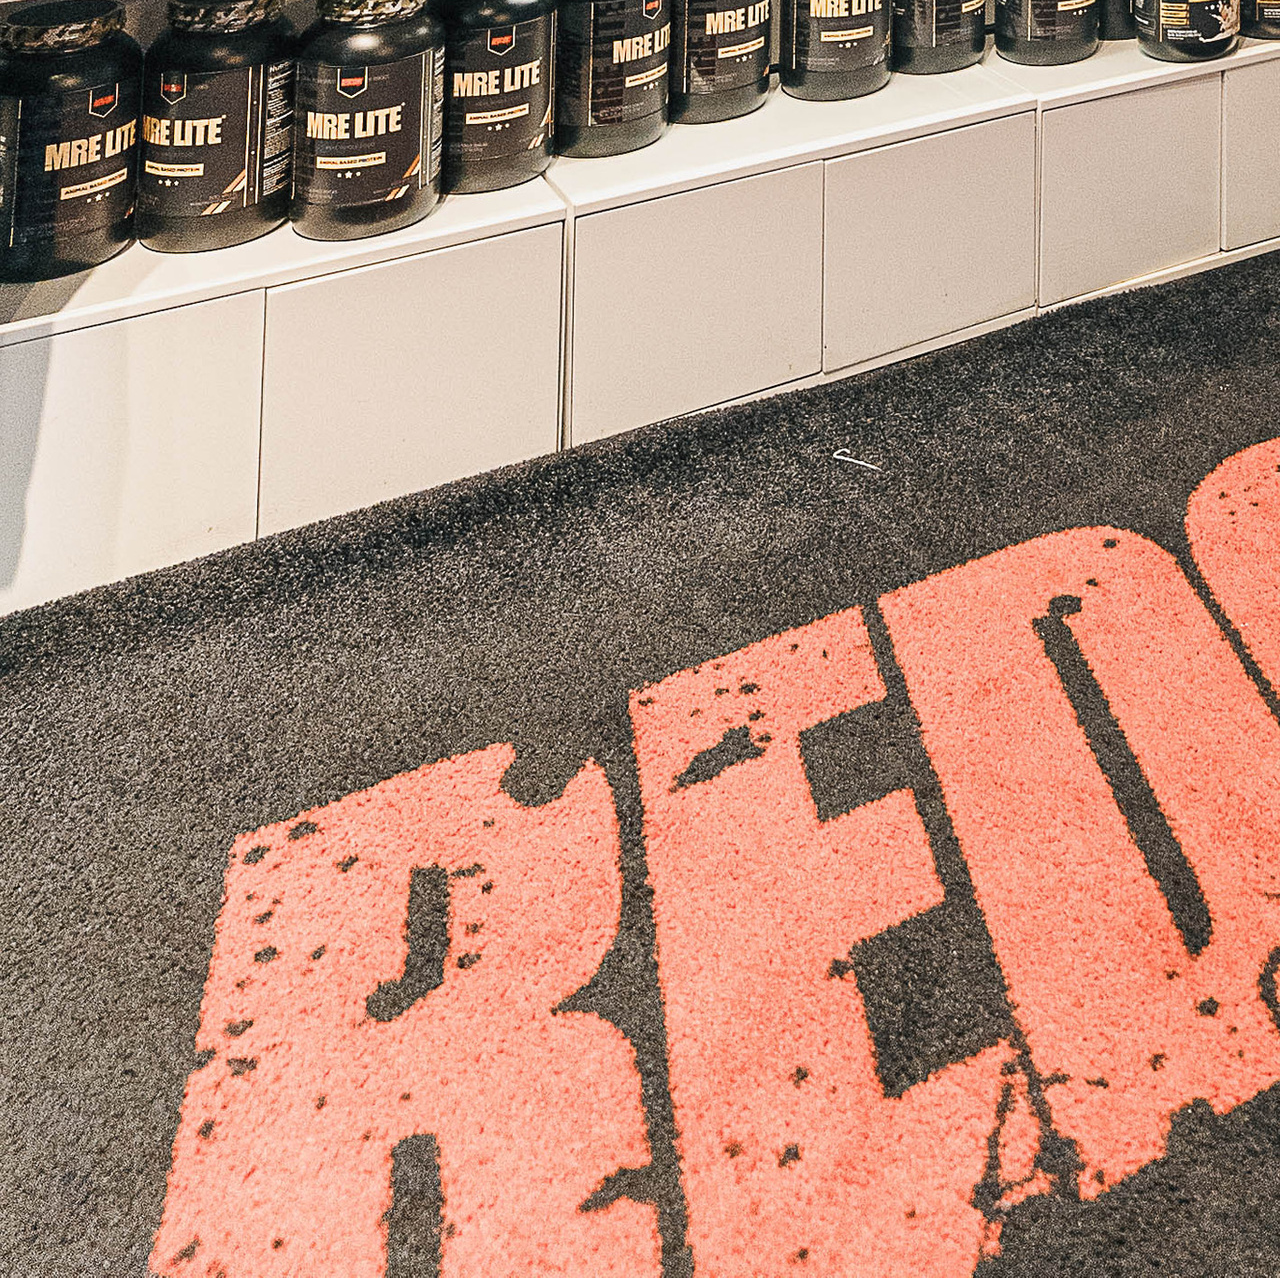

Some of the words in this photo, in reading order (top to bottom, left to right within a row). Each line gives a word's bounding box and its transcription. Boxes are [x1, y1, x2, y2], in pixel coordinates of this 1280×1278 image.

[705, 8, 746, 35] MRE
[613, 33, 653, 64] MRE
[453, 69, 501, 97] MRE
[503, 59, 541, 94] LITE
[173, 117, 223, 147] LITE
[306, 110, 351, 140] MRE
[354, 104, 402, 139] LITE
[44, 133, 104, 173] MRE
[104, 117, 137, 159] LITE
